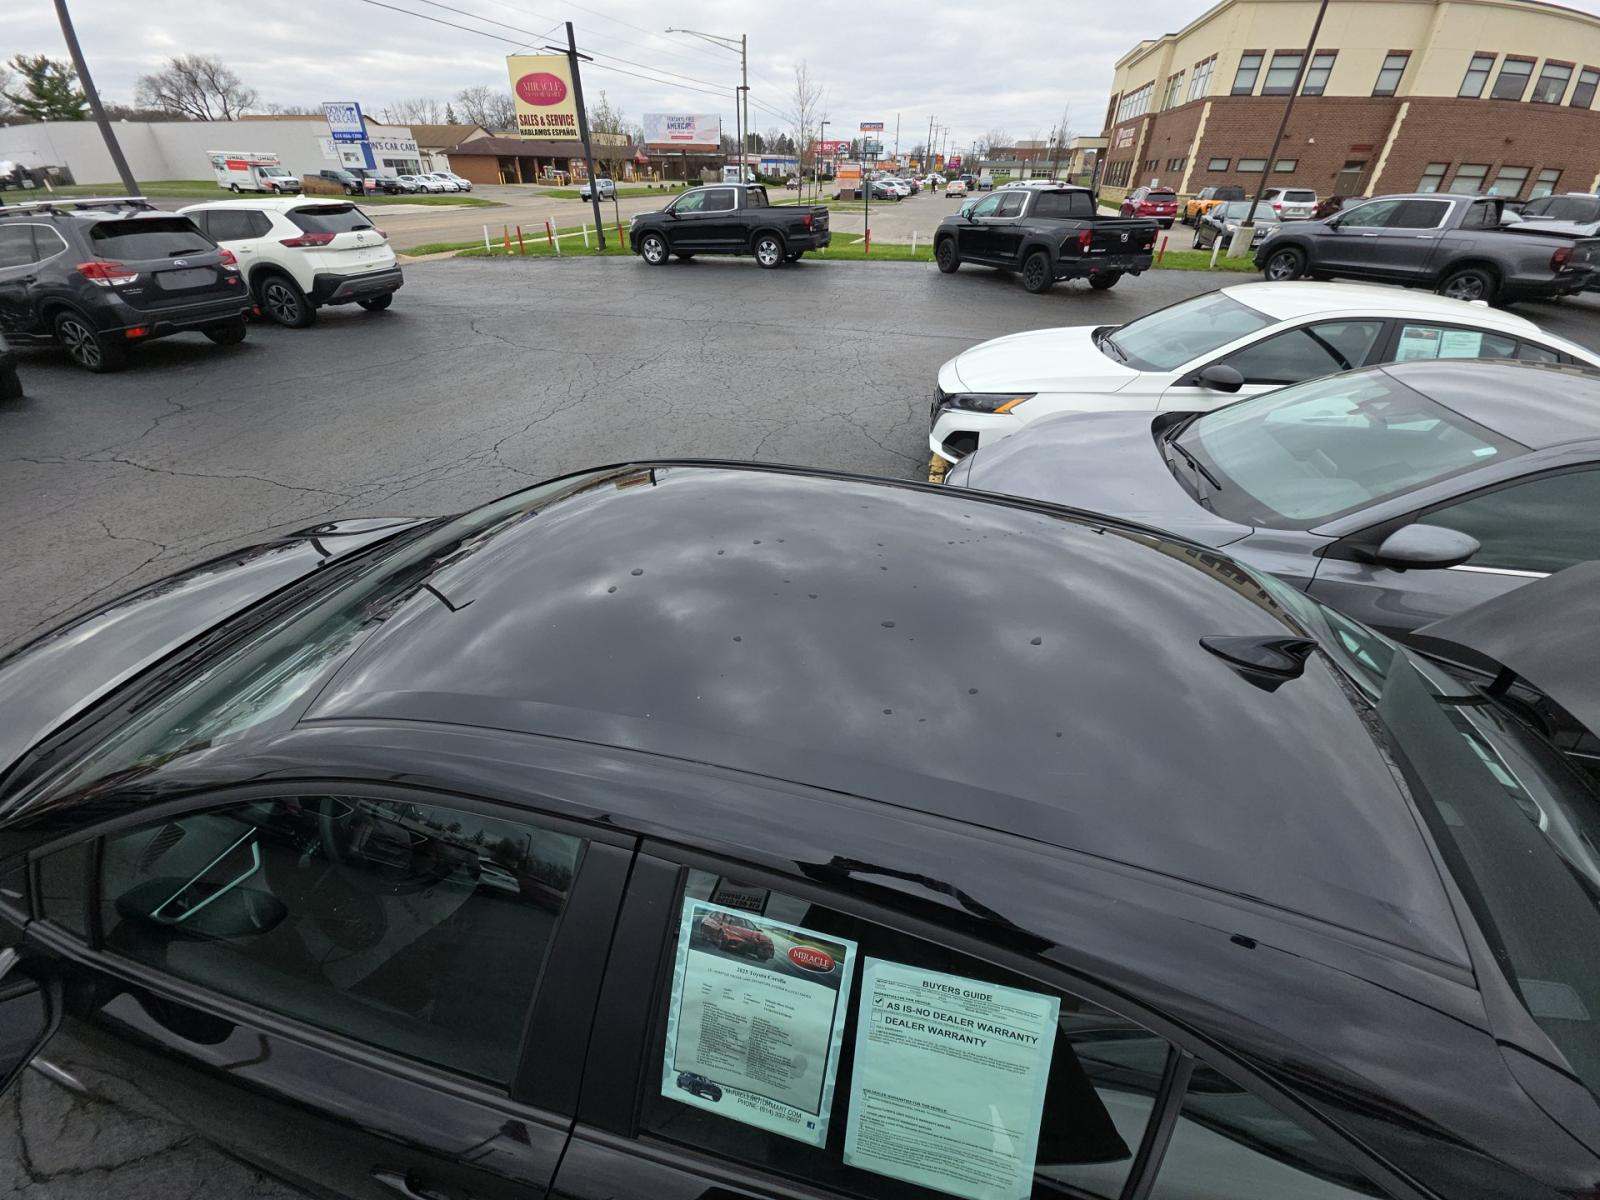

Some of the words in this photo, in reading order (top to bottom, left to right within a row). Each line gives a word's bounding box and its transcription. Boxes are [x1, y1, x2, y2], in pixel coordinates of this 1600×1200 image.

[522, 81, 562, 91] MIRACLE
[518, 114, 540, 126] SALES
[540, 116, 546, 126] &
[546, 114, 575, 126] SERVICE
[520, 128, 551, 137] HABLAMOS
[552, 129, 577, 137] ESPAÑOL
[385, 143, 399, 151] CAR
[400, 143, 417, 152] CARE
[793, 950, 830, 967] MIRACLE
[922, 981, 961, 995] BUYERS
[963, 990, 993, 1002] GUIDE
[886, 1002, 901, 1011] AS
[903, 1005, 931, 1017] IS-NO
[933, 1011, 975, 1028] DEALER
[977, 1022, 1039, 1045] WARRANTY
[885, 1016, 925, 1031] DEALER
[928, 1026, 987, 1048] WARRANTY
